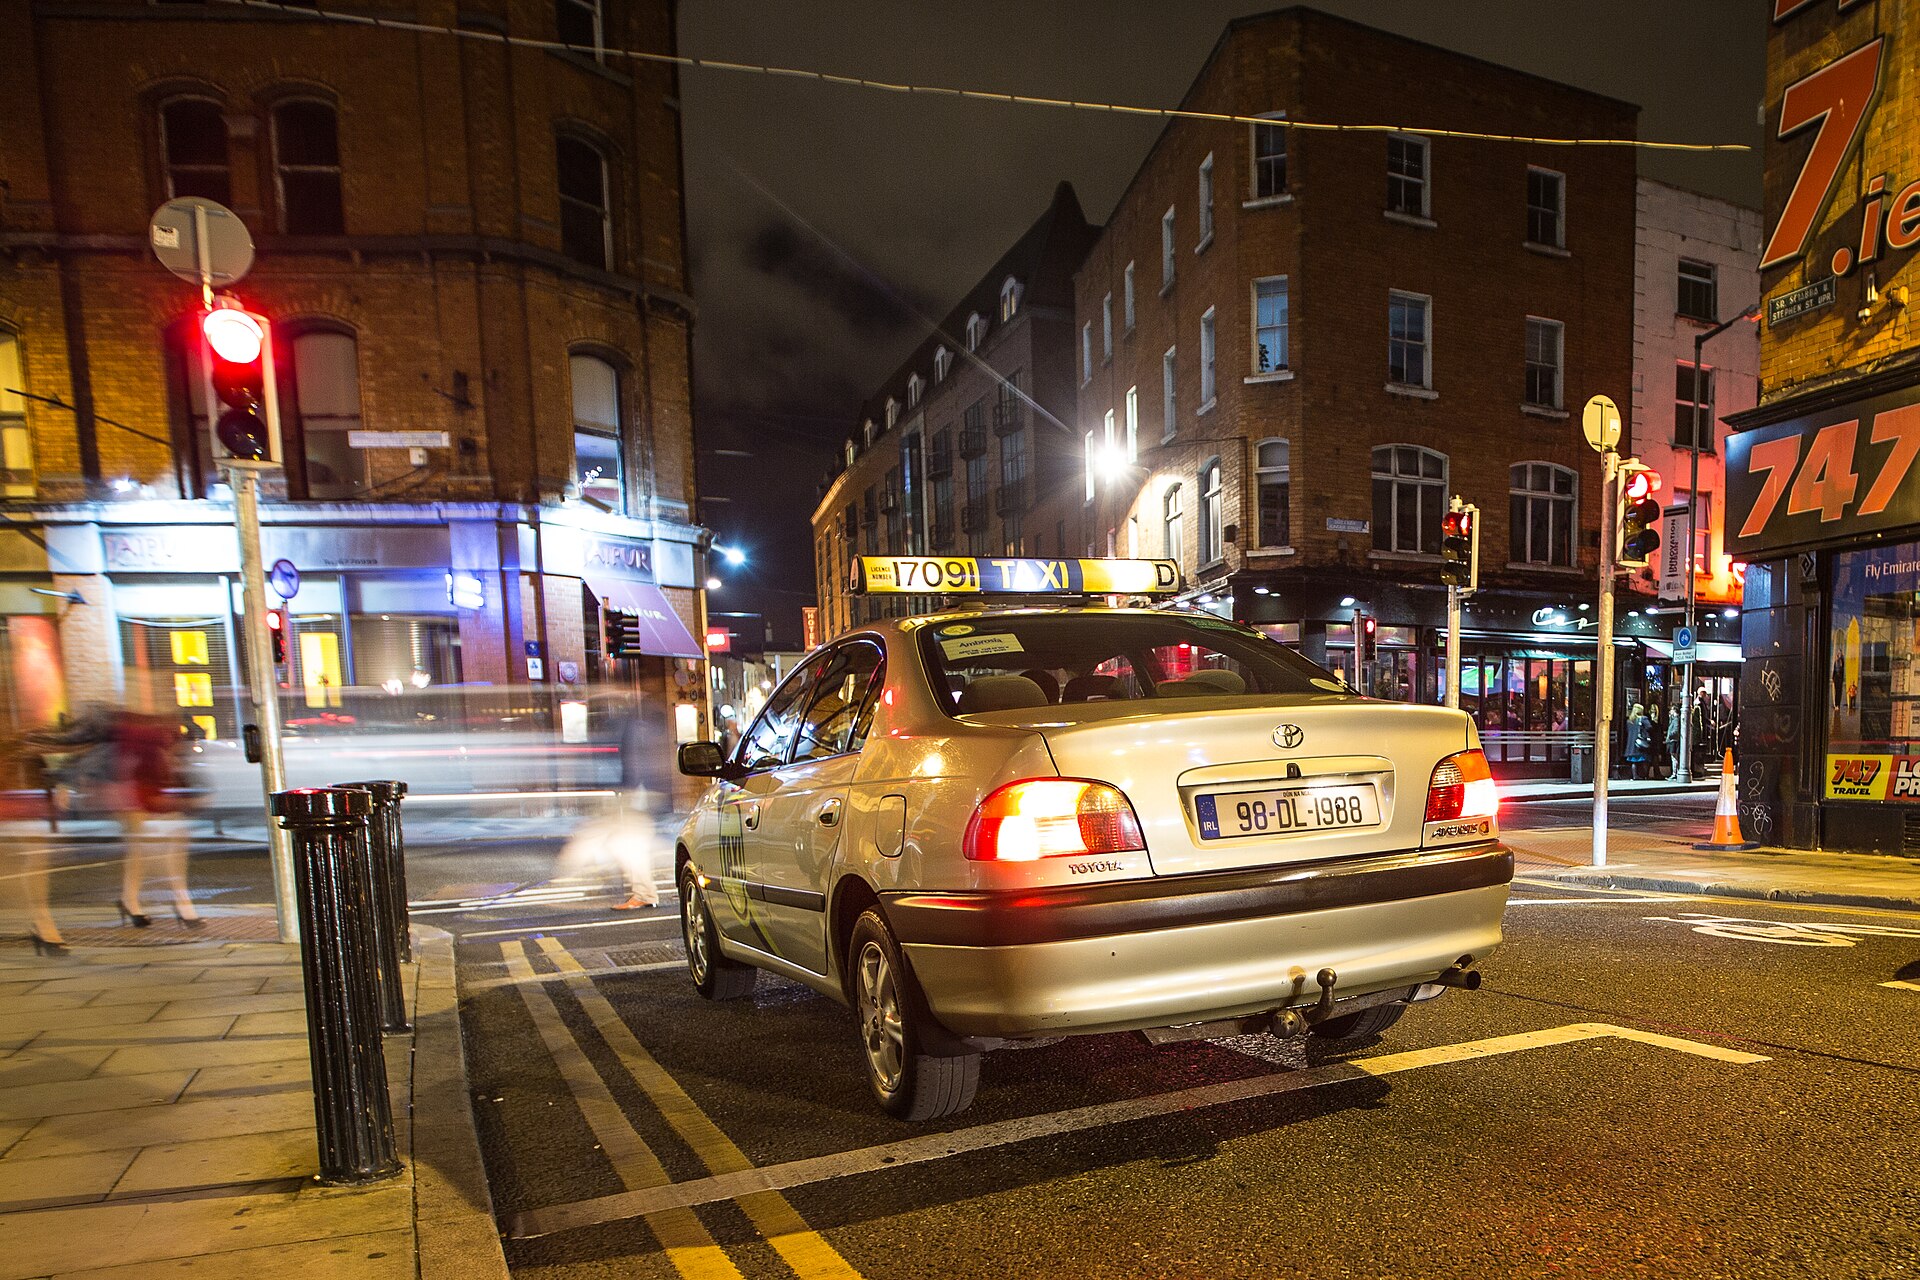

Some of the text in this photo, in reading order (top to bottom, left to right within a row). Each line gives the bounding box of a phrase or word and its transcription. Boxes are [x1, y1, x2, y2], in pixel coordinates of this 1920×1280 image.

[1772, 303, 1802, 321] STEPHEN
[1738, 403, 1920, 538] 747
[1668, 519, 1676, 573] INNOVATION
[893, 561, 976, 588] 17091
[991, 561, 1069, 589] TAXI
[1155, 563, 1175, 587] D
[1865, 564, 1881, 580] Fly
[807, 612, 816, 646] HOTEL
[959, 637, 1003, 648] Ambrosia
[1831, 759, 1882, 786] 747
[1833, 787, 1871, 796] TRAVEL
[1236, 795, 1363, 832] 98-DL-1988
[1203, 821, 1218, 832] IRL
[1068, 860, 1125, 875] TOYOTA
